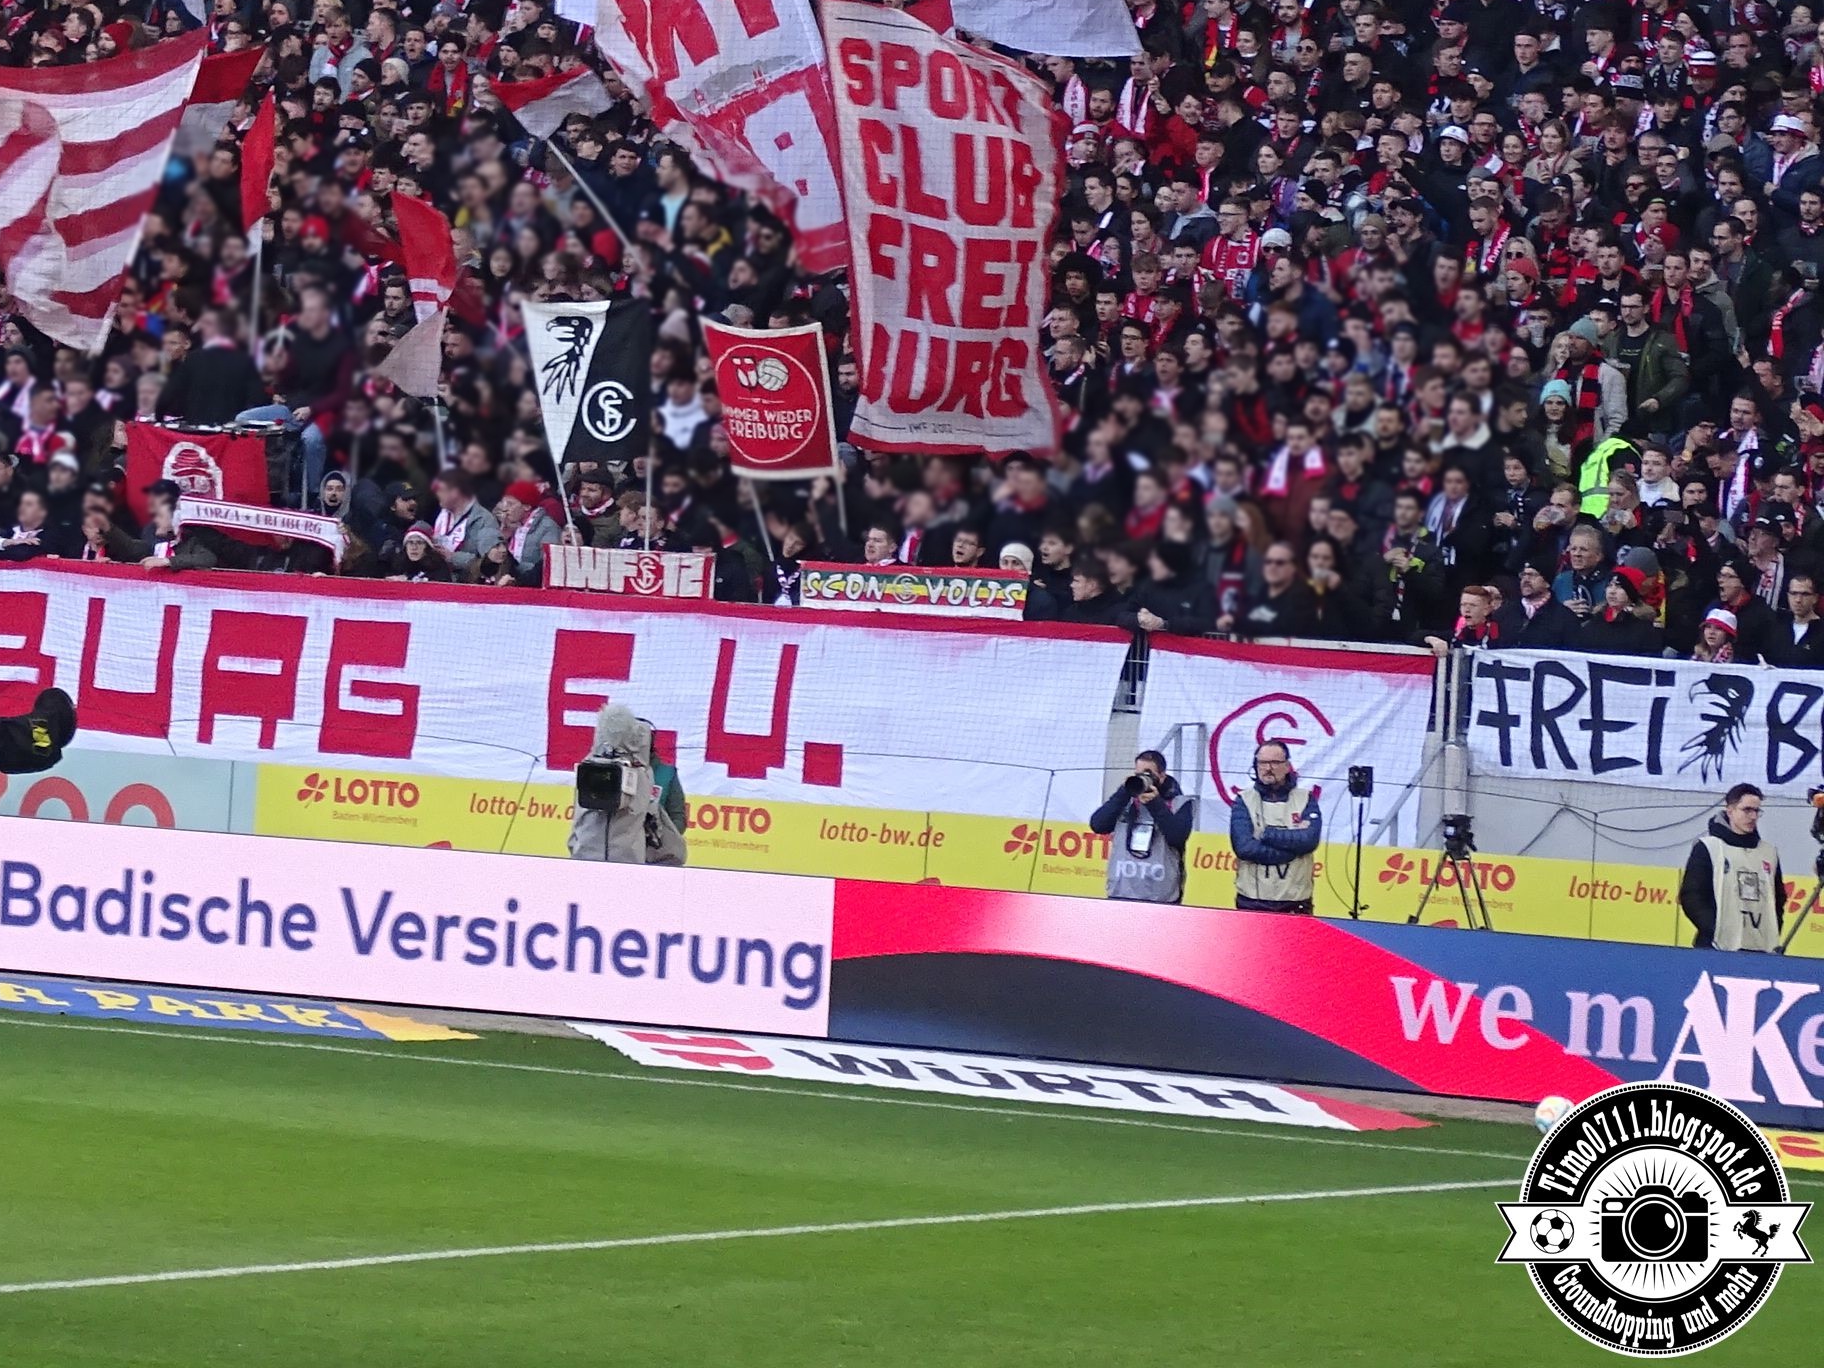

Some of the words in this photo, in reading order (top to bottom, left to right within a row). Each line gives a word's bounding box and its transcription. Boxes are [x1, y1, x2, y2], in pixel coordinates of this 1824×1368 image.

[867, 213, 1038, 331] FREI
[729, 418, 804, 440] FREIBURG
[764, 409, 812, 423] WIEDER
[256, 514, 322, 534] FREIBURG
[550, 544, 639, 593] IWF
[925, 577, 1024, 608] VOLTS
[333, 777, 420, 809] LOTTO
[685, 803, 773, 835] LOTTO
[819, 818, 946, 848] lotto-bw.de
[1043, 828, 1109, 861] LOTT
[1418, 857, 1516, 892] LOTTO
[0, 860, 317, 954] Badische
[339, 885, 824, 1010] Versicherung
[1739, 910, 1762, 930] TV
[75, 986, 362, 1031] PARK
[1389, 975, 1534, 1051] we
[782, 1048, 1290, 1115] WÜRTH
